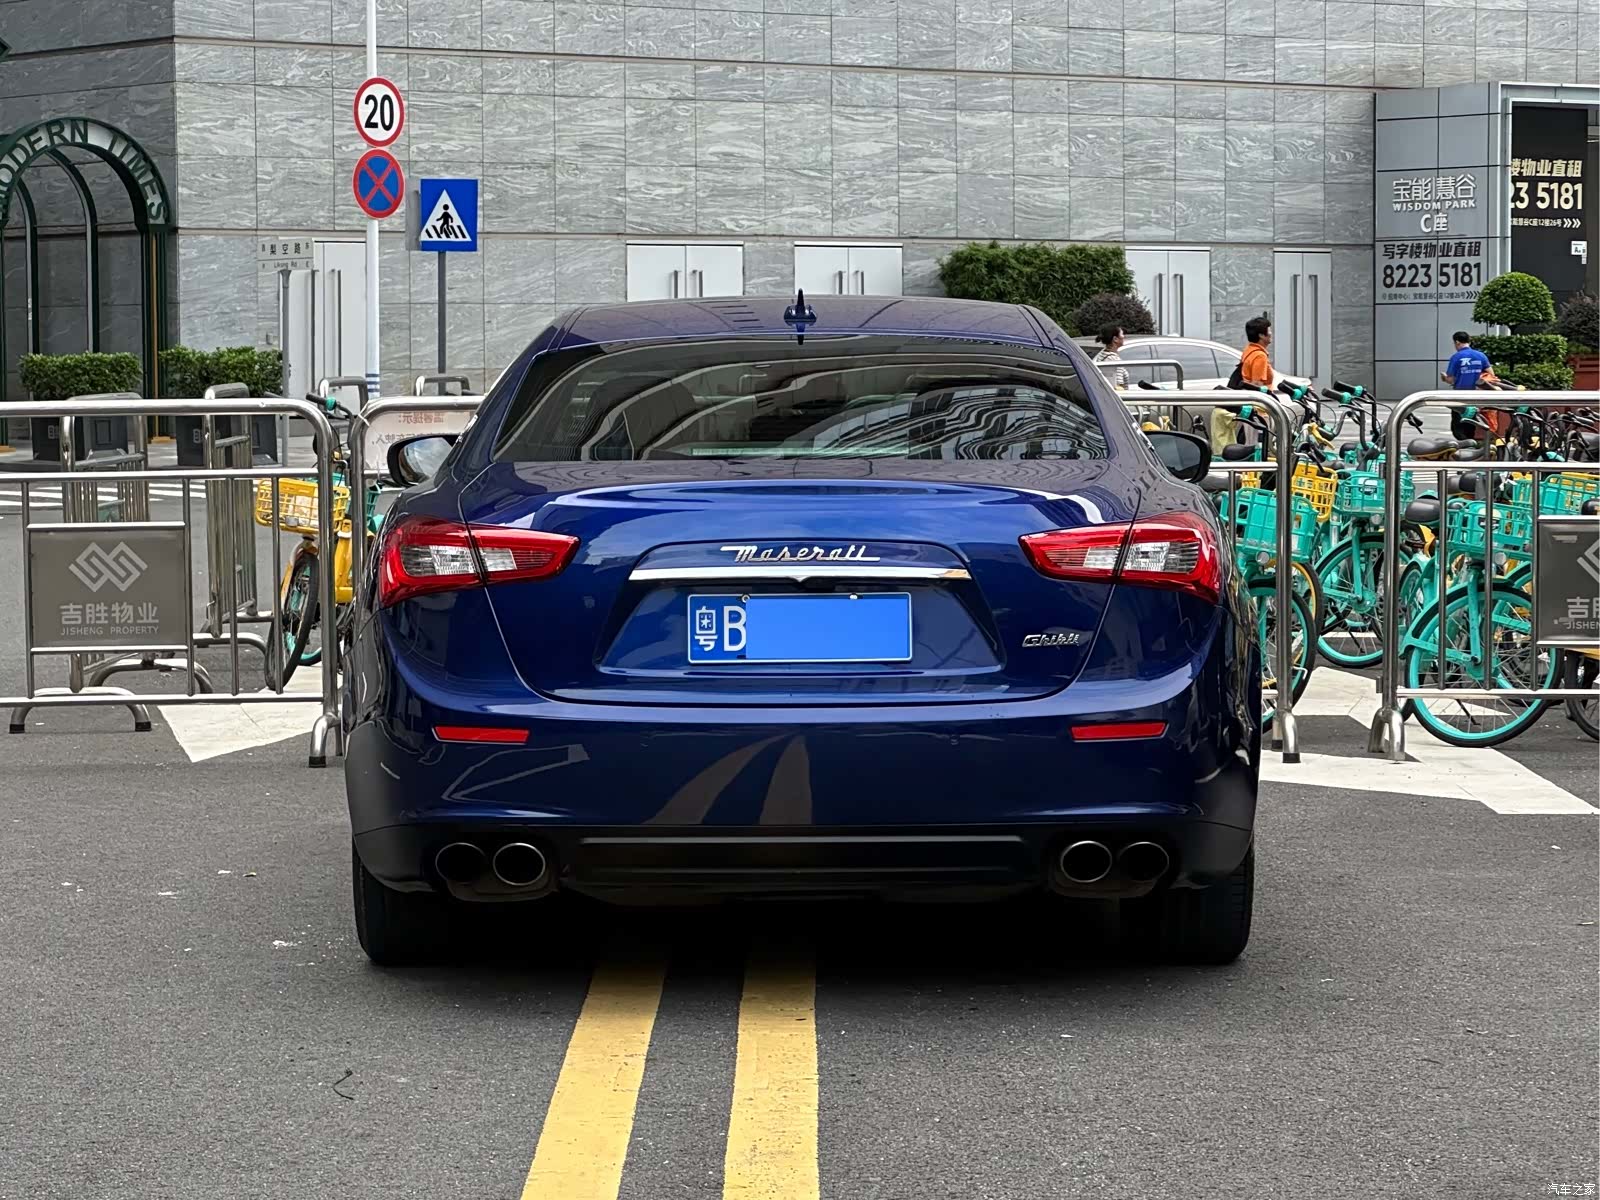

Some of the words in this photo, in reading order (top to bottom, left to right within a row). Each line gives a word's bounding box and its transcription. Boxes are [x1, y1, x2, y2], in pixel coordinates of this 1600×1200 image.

[364, 94, 394, 131] 20
[107, 132, 167, 221] TIMES
[1392, 201, 1441, 211] WISDOM
[1445, 199, 1476, 209] PARK
[1536, 182, 1582, 210] 5181
[1420, 213, 1448, 233] C座
[1382, 241, 1481, 259] 写字楼物业直租
[1382, 264, 1432, 289] 8223
[1439, 262, 1481, 287] 5181
[720, 544, 880, 562] Maserati
[60, 602, 159, 625] 吉胜物业
[60, 627, 103, 636] JISHENG
[110, 625, 159, 635] PROPERTY
[1022, 633, 1080, 648] Ghibli
